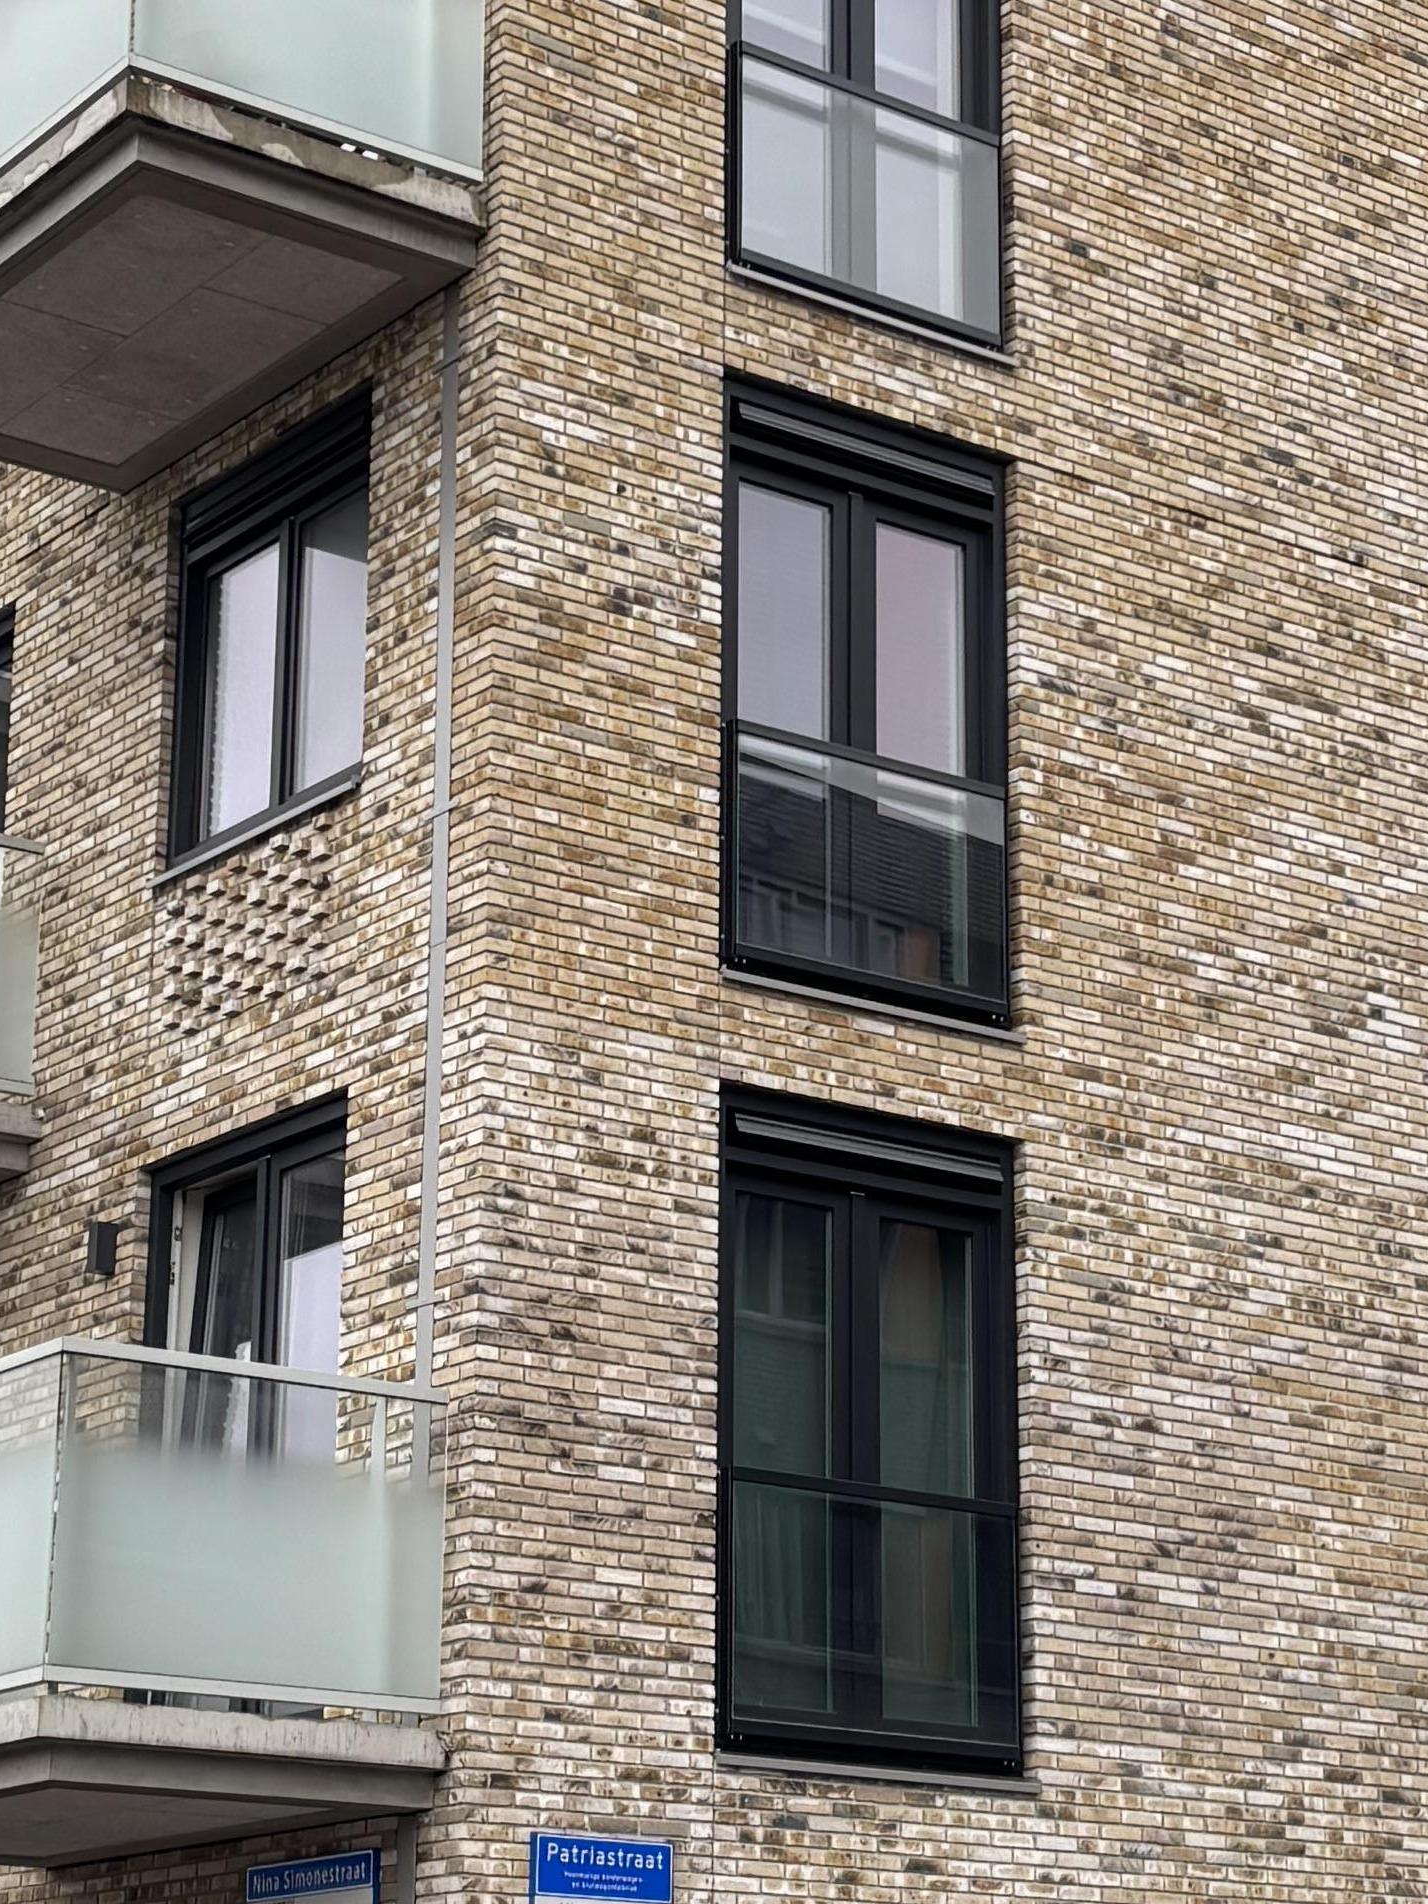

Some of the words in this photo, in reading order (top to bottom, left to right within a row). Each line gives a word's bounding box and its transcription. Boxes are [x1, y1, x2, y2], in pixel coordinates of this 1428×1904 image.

[547, 1842, 663, 1870] Patriastraat
[253, 1872, 280, 1894] Nina
[283, 1861, 366, 1890] Simonestraat
